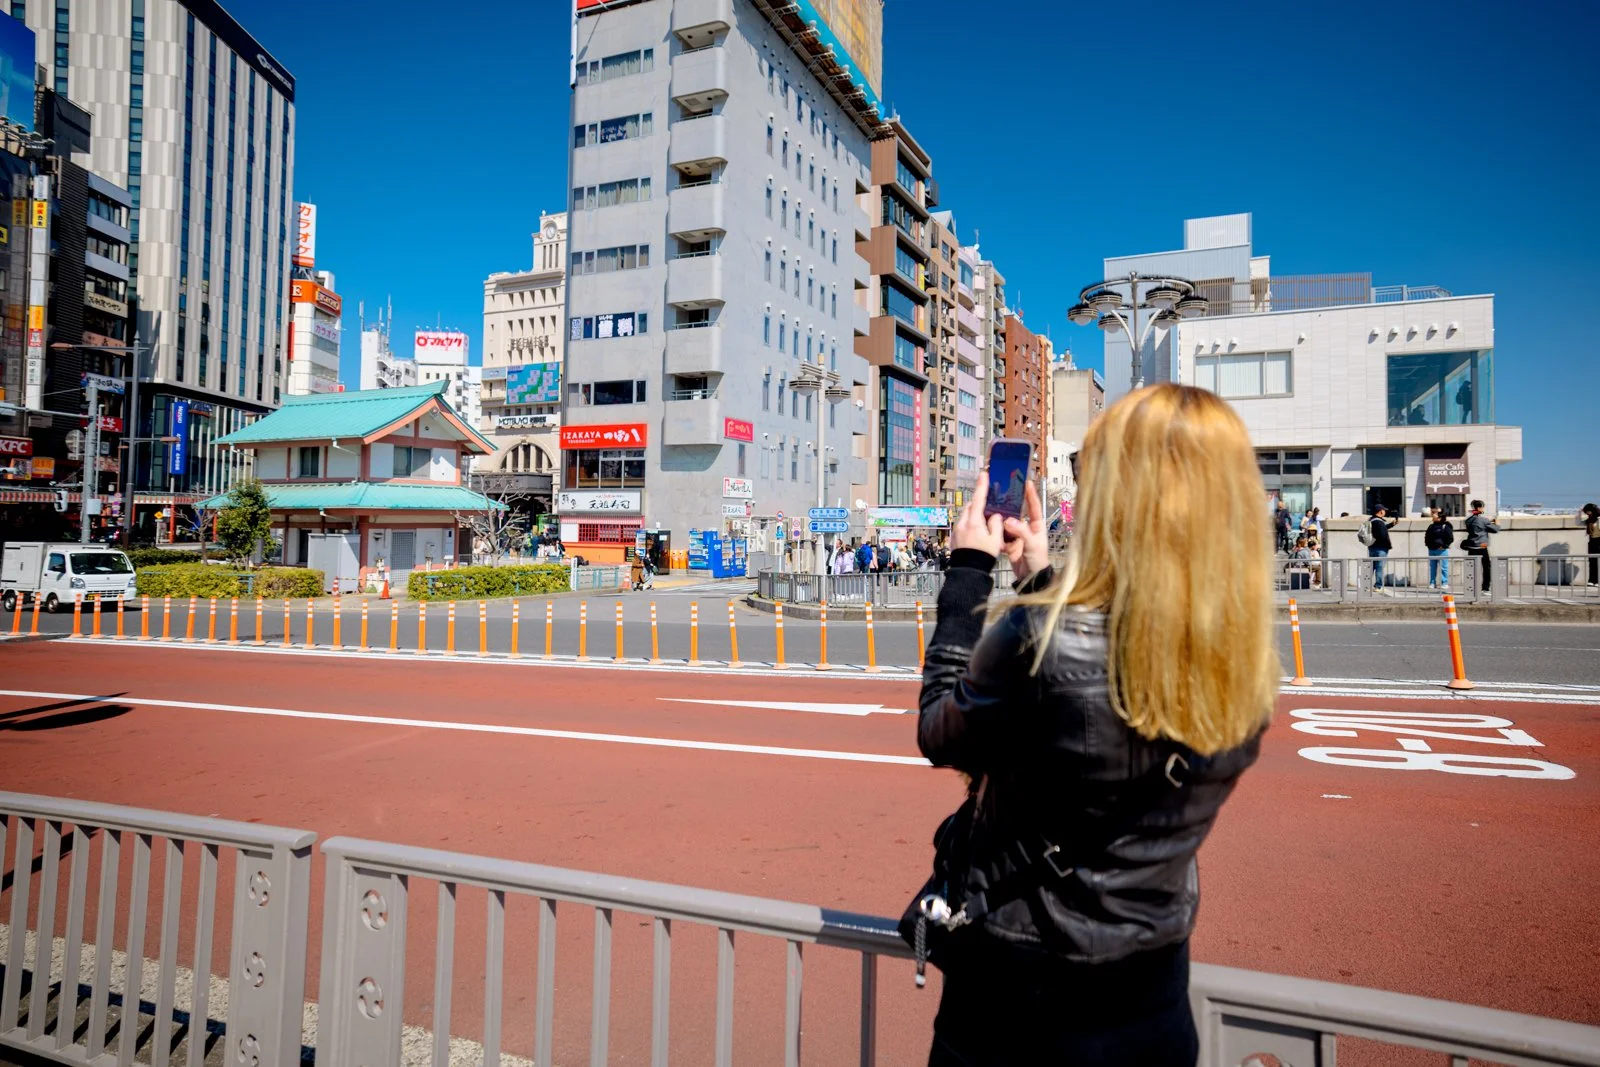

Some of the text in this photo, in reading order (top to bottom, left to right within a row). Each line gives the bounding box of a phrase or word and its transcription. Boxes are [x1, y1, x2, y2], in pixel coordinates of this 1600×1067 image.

[296, 204, 311, 254] カラオケ
[315, 324, 337, 340] カラオケ
[563, 428, 641, 442] IZAKAYA つぼ八
[0, 440, 27, 453] KFC
